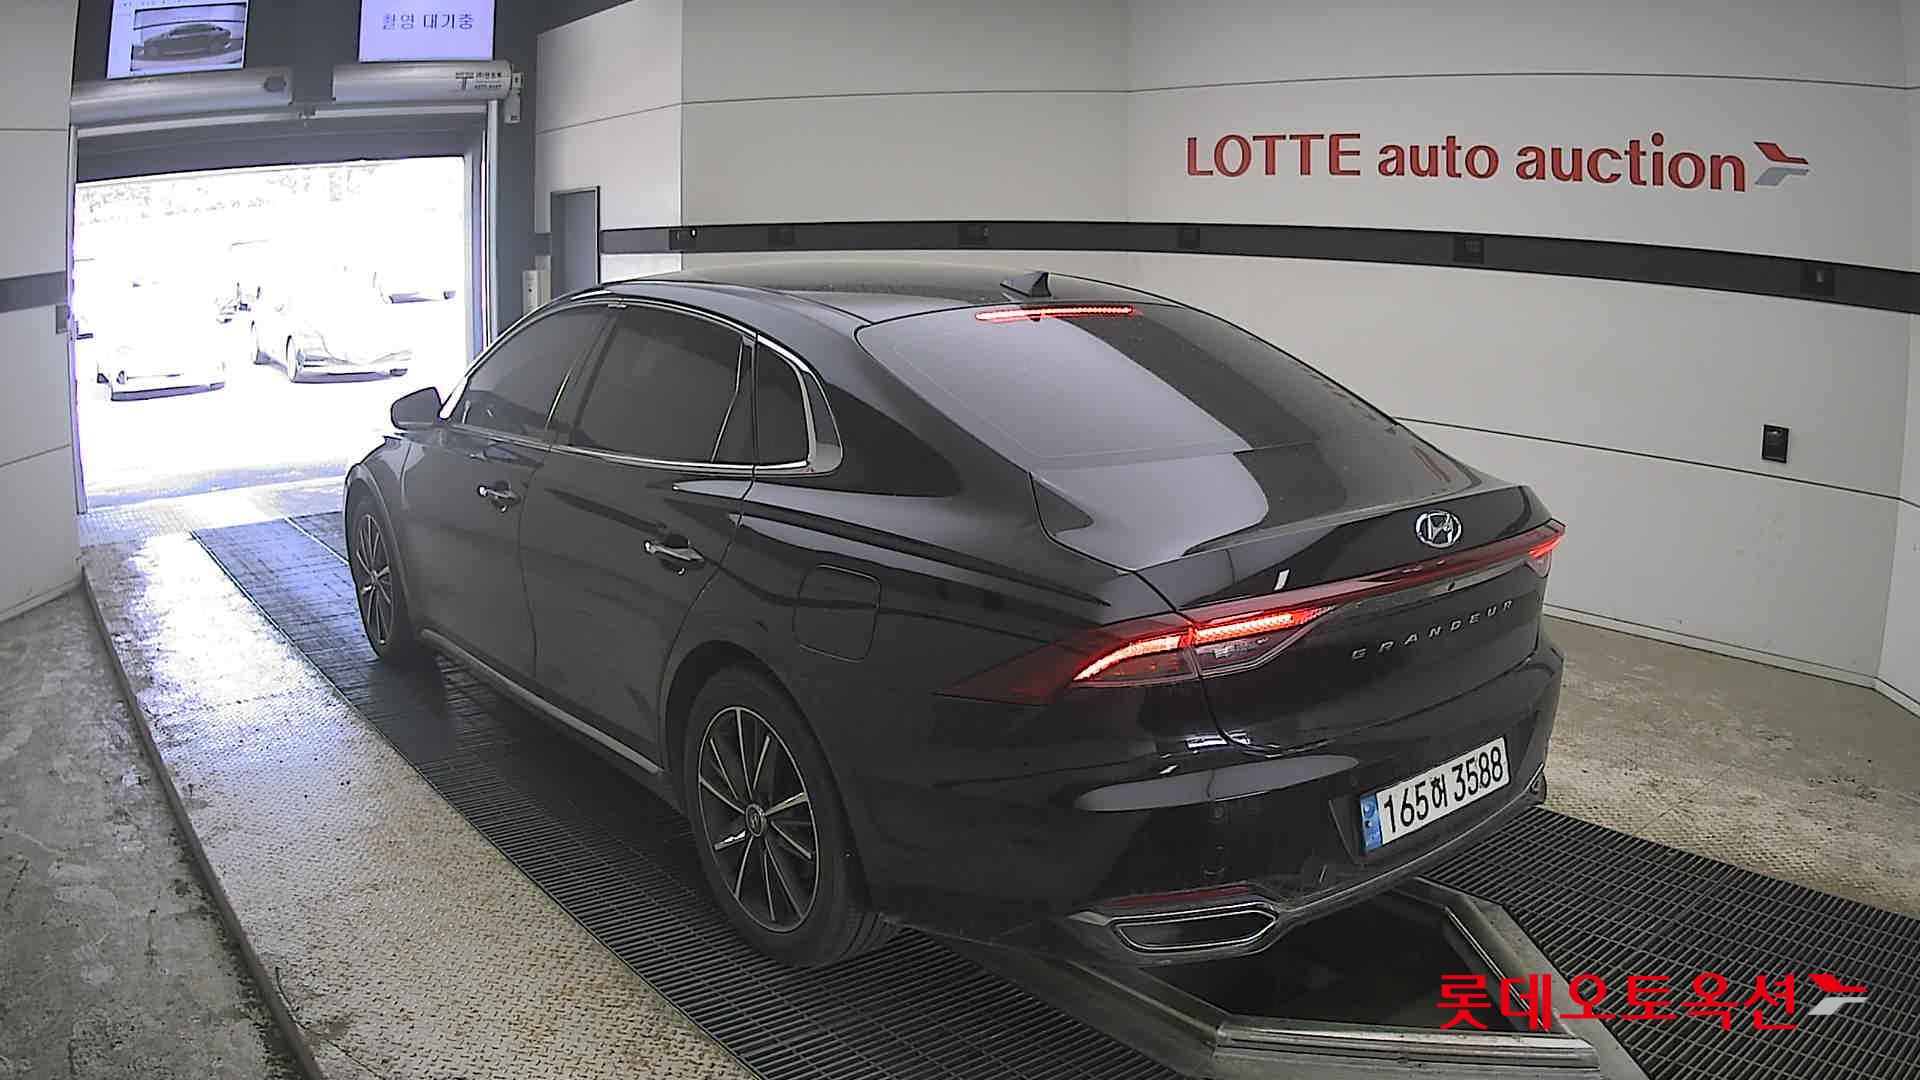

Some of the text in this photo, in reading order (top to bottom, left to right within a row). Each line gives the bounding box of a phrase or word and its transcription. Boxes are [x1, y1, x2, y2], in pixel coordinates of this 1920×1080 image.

[423, 13, 473, 30] 대기중
[1186, 132, 1746, 192] LOTTE auto auction
[1351, 599, 1513, 660] GRANDEUR
[1383, 745, 1504, 834] 165허 3588
